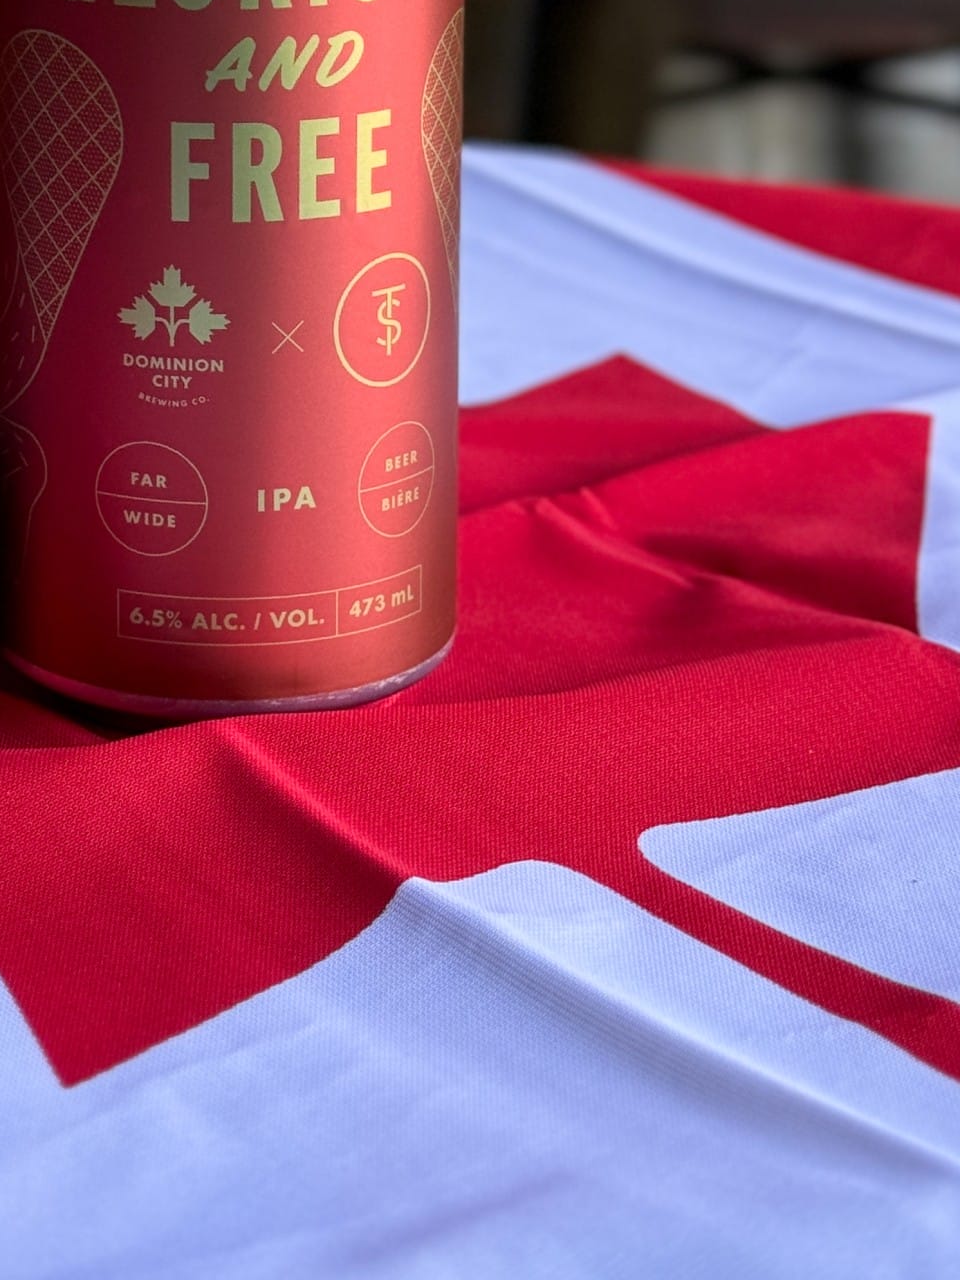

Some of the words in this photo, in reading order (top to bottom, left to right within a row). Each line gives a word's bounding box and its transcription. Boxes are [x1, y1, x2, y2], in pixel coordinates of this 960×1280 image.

[205, 29, 365, 93] AND
[170, 108, 392, 224] FREE
[123, 353, 225, 374] DOMINION
[152, 374, 192, 390] CITY
[138, 391, 188, 408] BREWING
[191, 395, 210, 406] CO.
[384, 450, 419, 473] BEER
[130, 472, 168, 489] FAR
[257, 486, 317, 512] IPA
[381, 486, 420, 513] BIÈRE
[124, 510, 177, 529] WIDE
[349, 595, 386, 619] 473
[390, 584, 415, 606] mL
[129, 607, 182, 630] 6.5%
[191, 611, 246, 631] ALC.
[269, 605, 325, 628] VOL.
